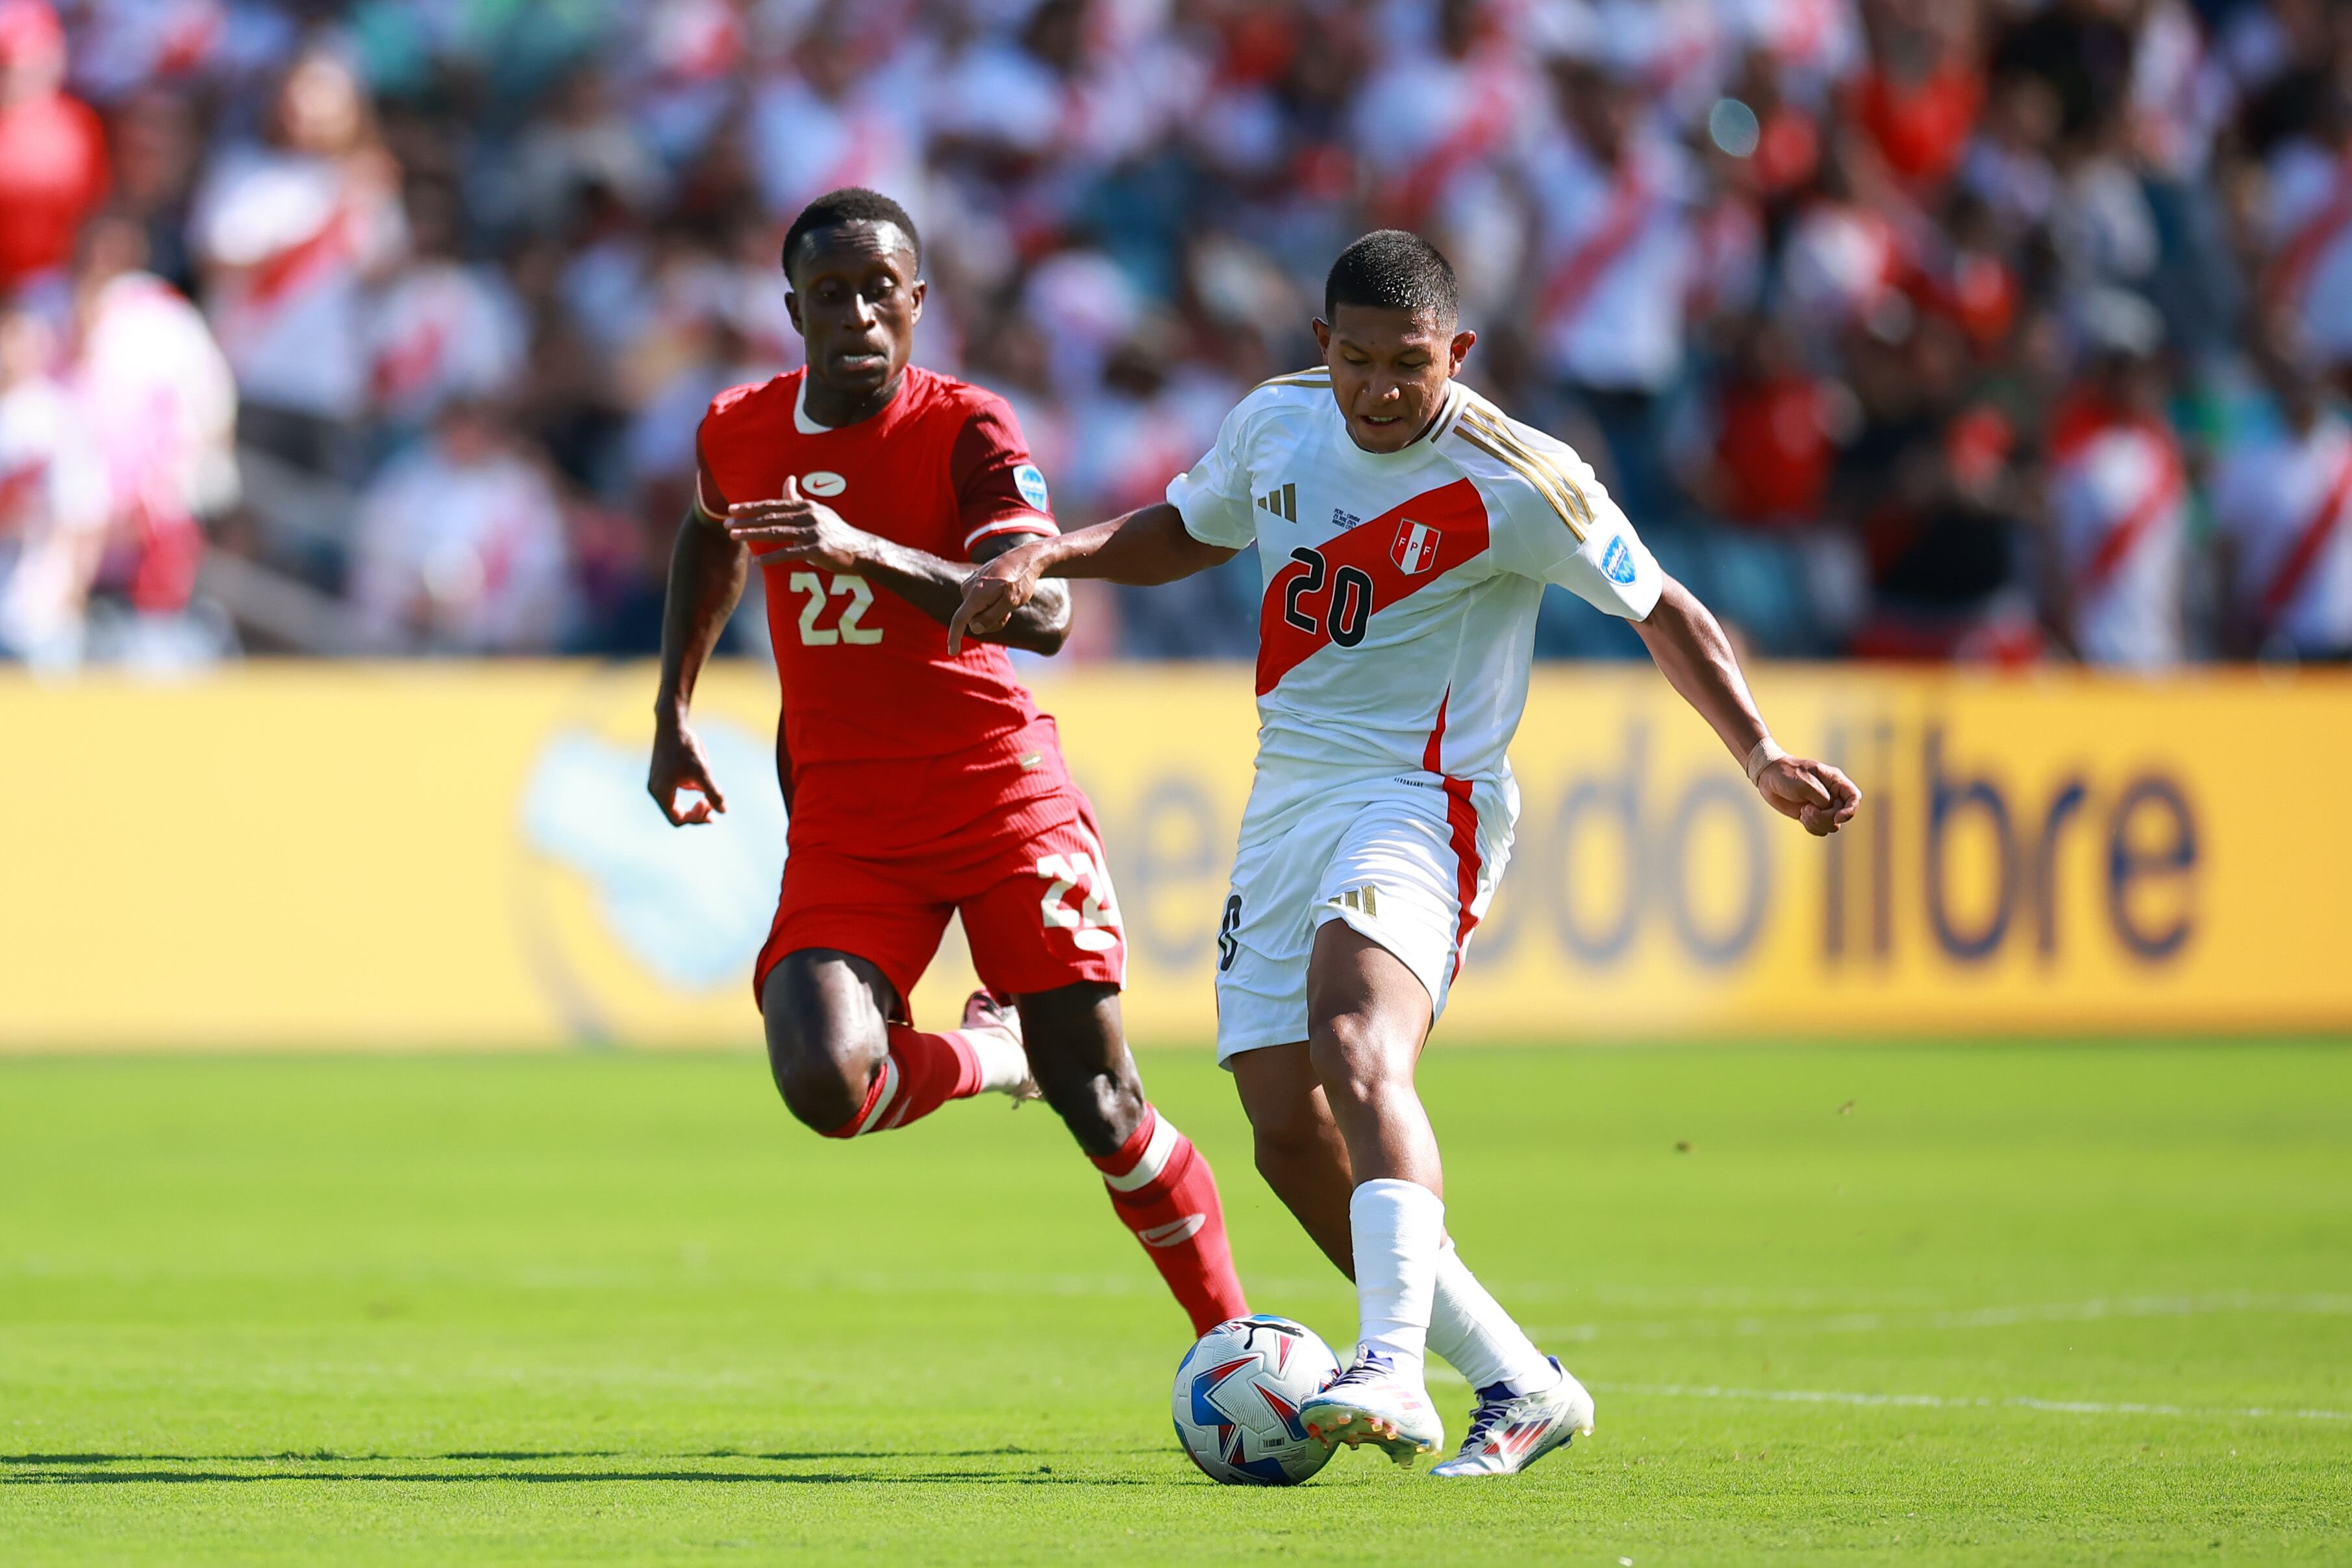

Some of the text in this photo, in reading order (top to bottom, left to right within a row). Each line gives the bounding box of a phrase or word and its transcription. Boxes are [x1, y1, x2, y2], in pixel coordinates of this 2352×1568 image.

[790, 571, 883, 645] 22
[1284, 545, 1373, 649] 20
[1822, 719, 2196, 964] libre
[1036, 852, 1118, 928] 22
